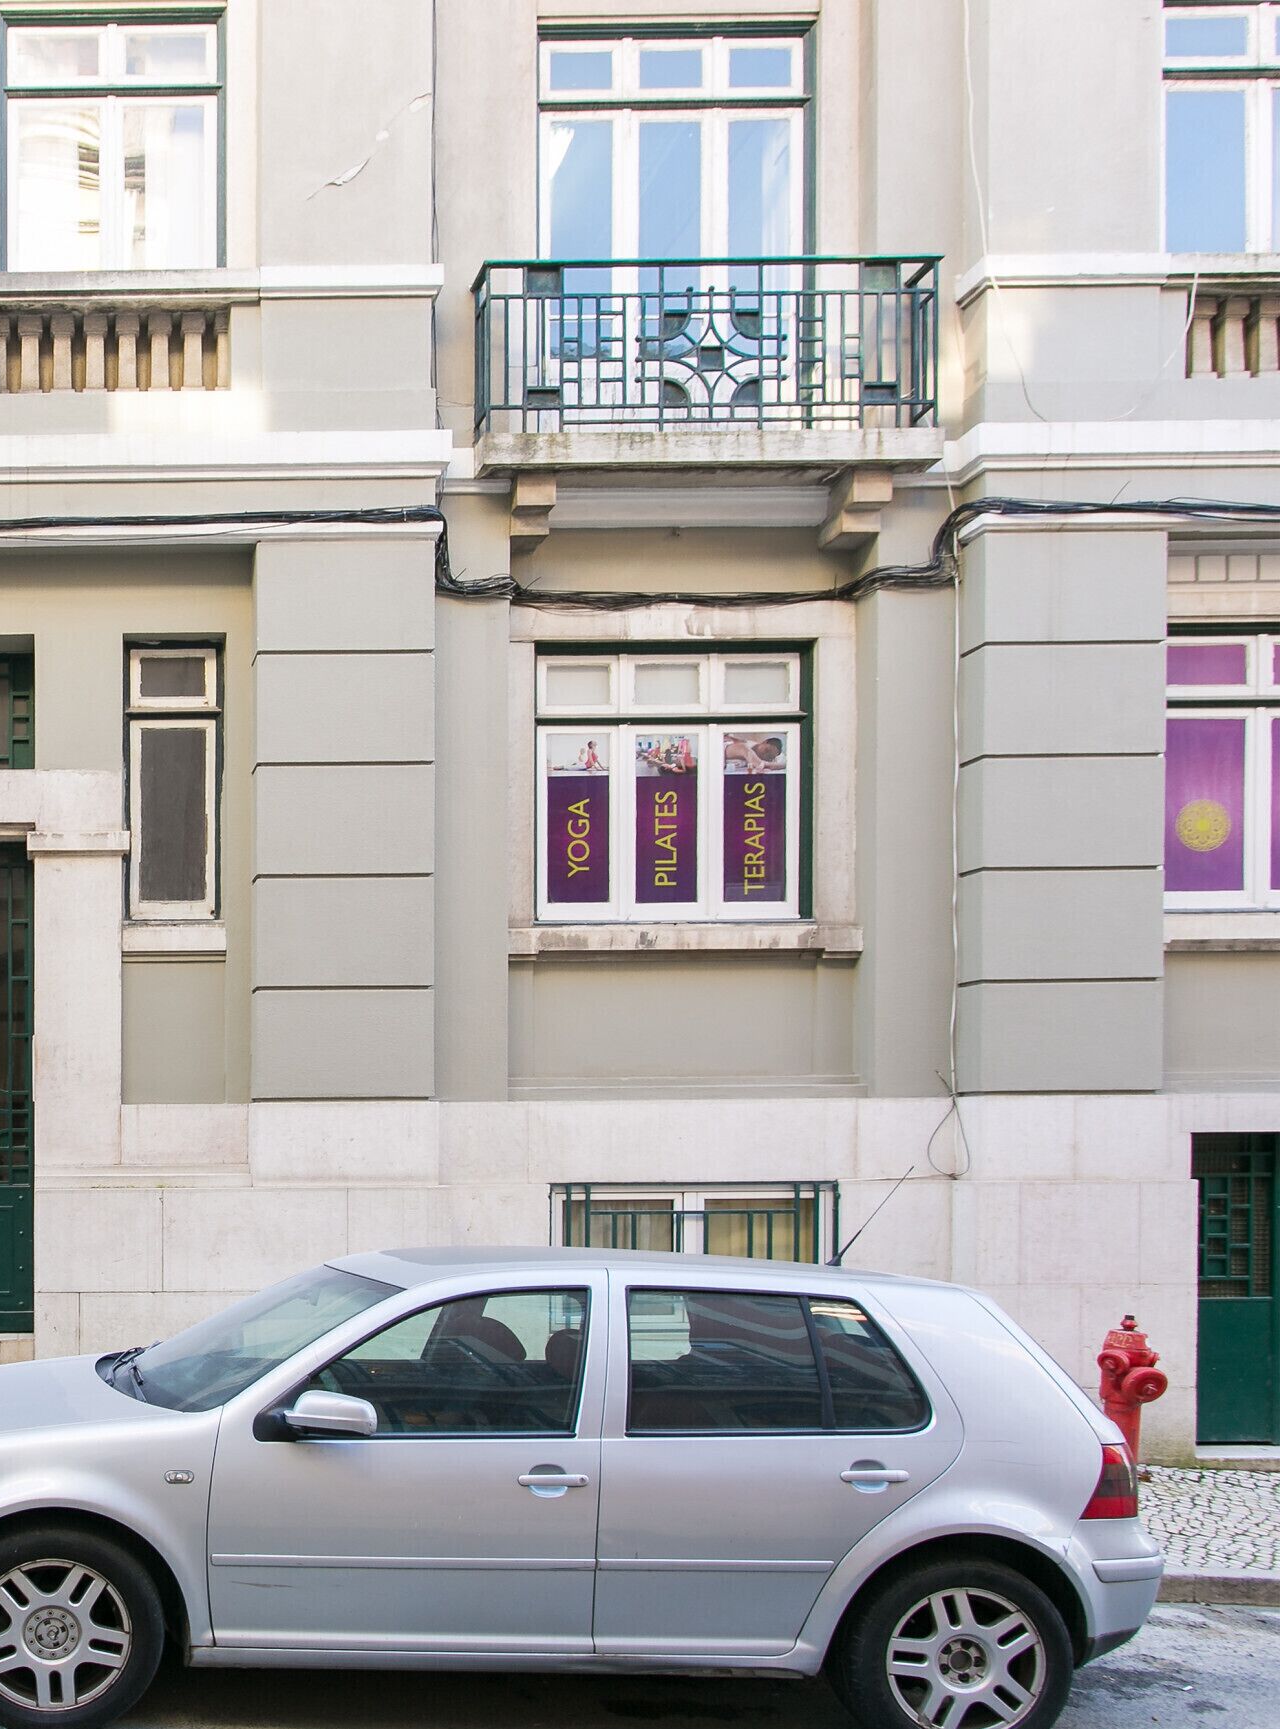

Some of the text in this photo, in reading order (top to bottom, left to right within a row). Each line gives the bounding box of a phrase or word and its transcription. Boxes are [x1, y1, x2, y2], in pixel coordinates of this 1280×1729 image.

[567, 798, 590, 878] YOGA
[654, 790, 678, 887] PILATES
[744, 782, 765, 895] TERAPIAS
